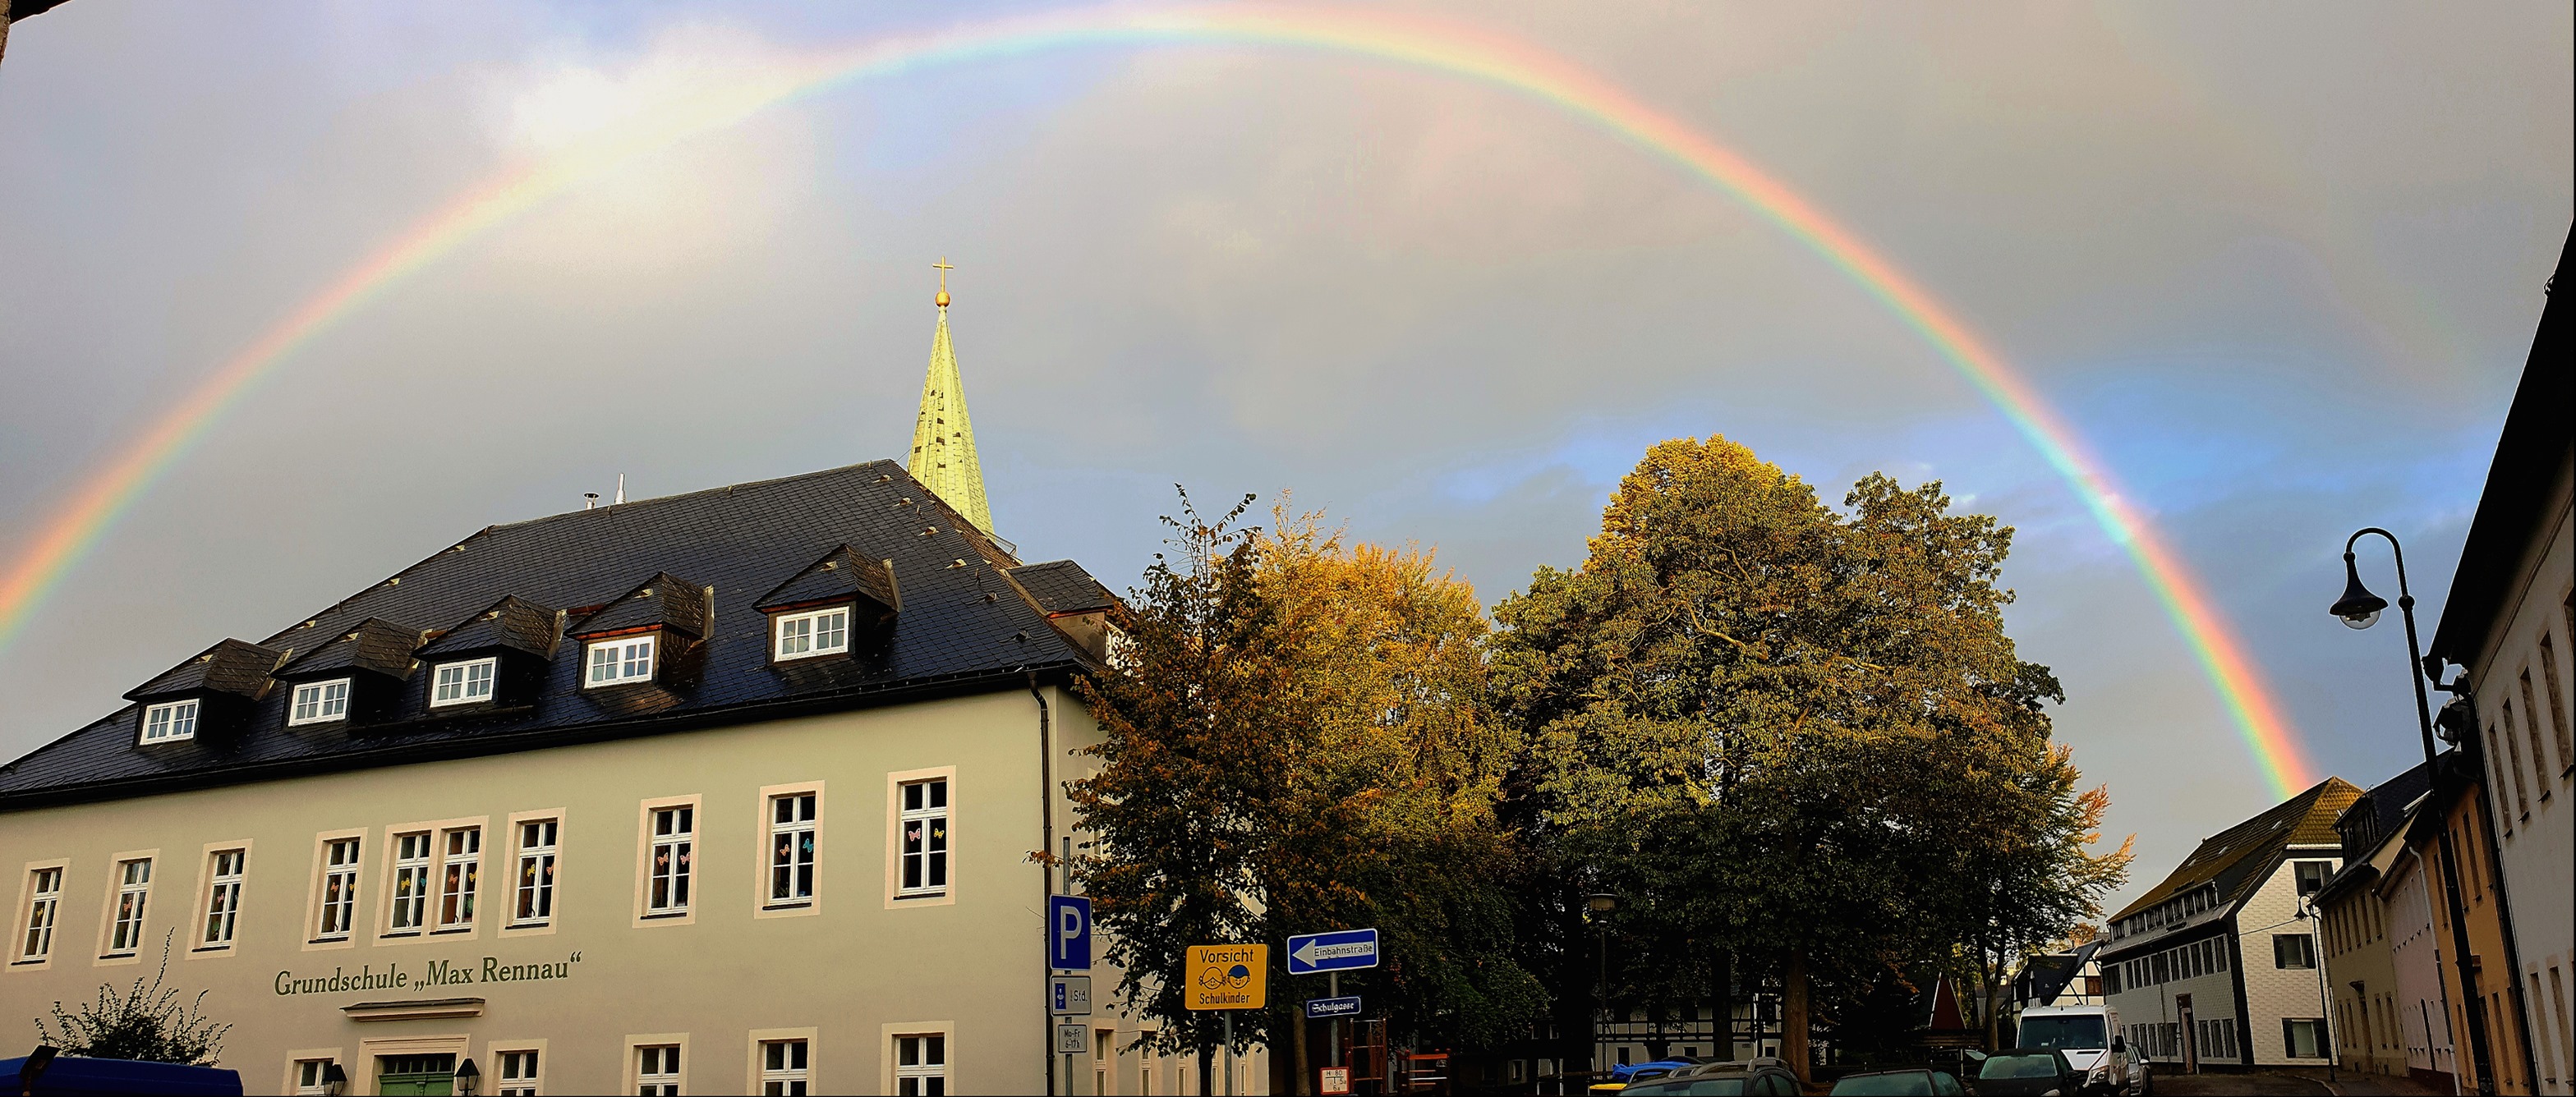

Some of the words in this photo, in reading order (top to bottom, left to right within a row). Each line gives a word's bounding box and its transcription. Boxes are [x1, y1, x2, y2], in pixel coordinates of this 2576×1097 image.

[1060, 905, 1082, 959] P
[1199, 948, 1254, 963] Vorsicht
[1314, 944, 1373, 957] Einbahnstraße
[274, 962, 407, 995] Grundschule
[1074, 989, 1088, 1002] Std.
[1199, 992, 1250, 1004] Schulkinder
[1312, 1003, 1355, 1013] Schulgasse
[1064, 1028, 1081, 1038] Mo-Fr
